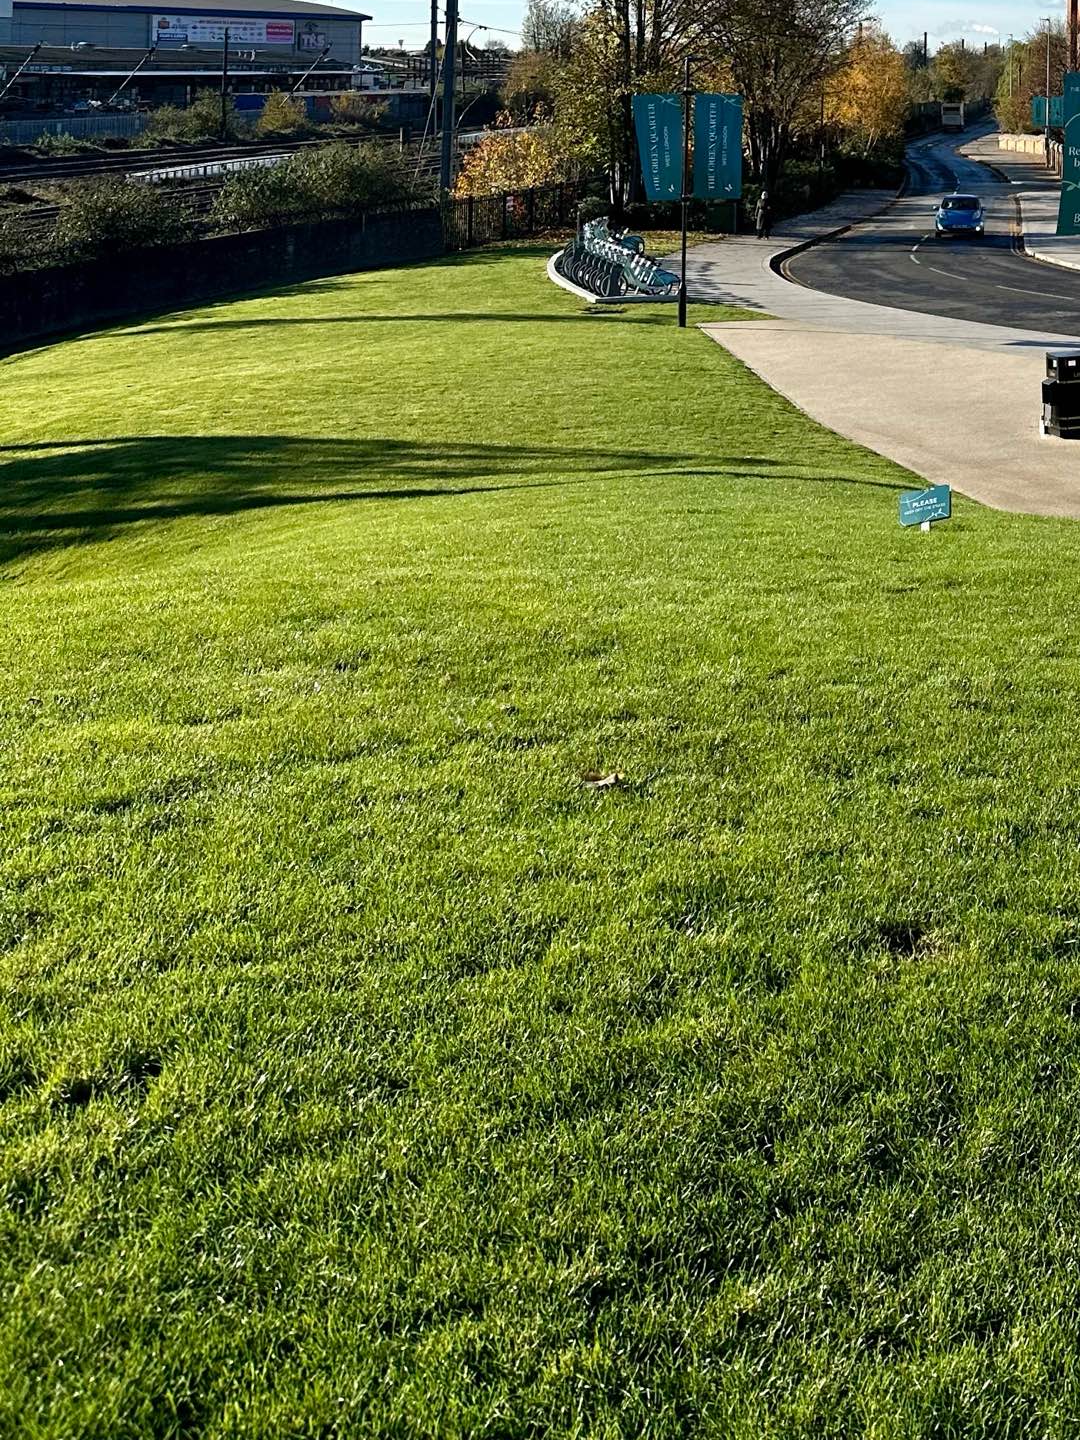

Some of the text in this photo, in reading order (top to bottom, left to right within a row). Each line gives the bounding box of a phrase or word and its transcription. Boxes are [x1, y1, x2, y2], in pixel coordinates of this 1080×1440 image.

[647, 103, 659, 143] QUARTER
[708, 102, 718, 142] QUARTER
[649, 144, 659, 173] GREEN
[708, 143, 716, 172] GREEN
[912, 498, 938, 508] PLEASE
